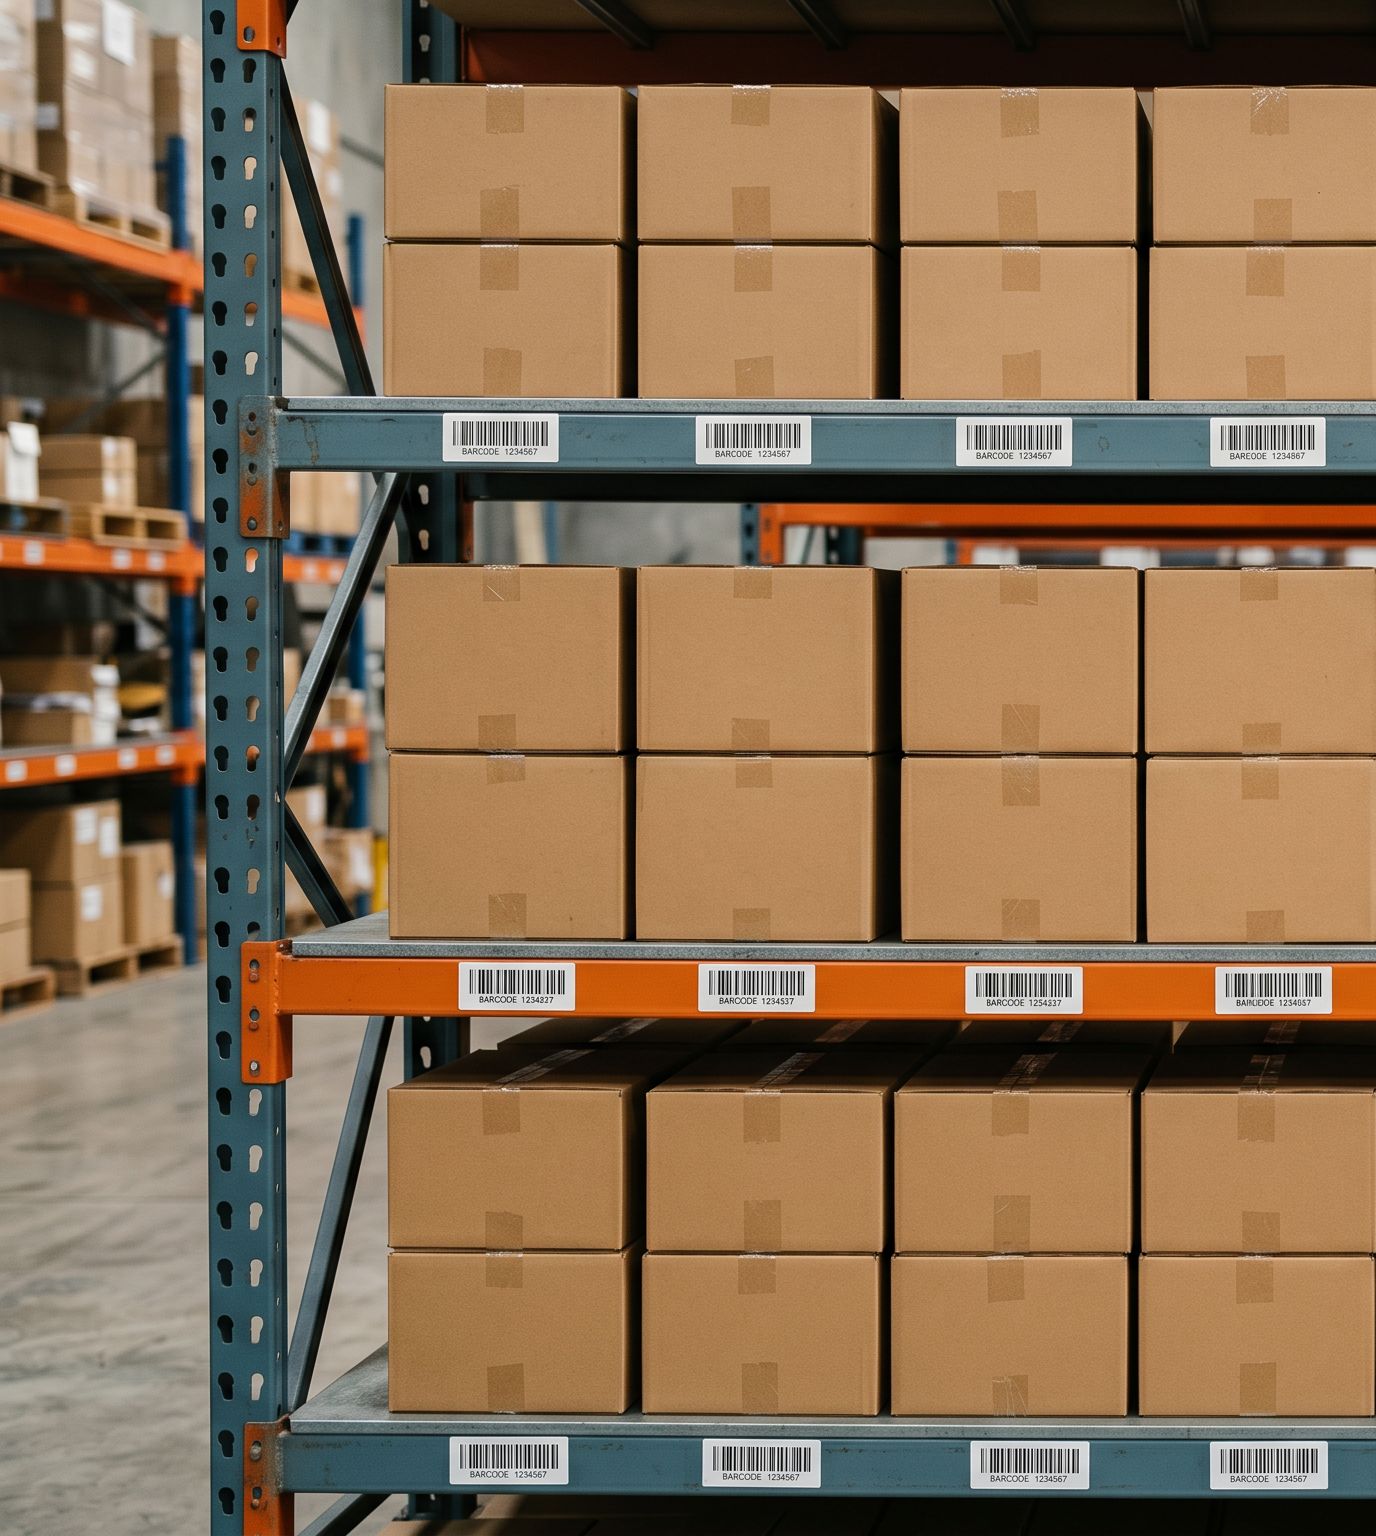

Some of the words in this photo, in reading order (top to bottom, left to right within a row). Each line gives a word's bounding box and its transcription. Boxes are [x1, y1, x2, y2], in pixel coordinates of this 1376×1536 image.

[504, 447, 538, 456] 1234567
[758, 449, 791, 458] 1234567
[1019, 451, 1053, 460] 1234567
[514, 1470, 548, 1479] 1234567
[722, 1472, 762, 1482] BARCODE
[767, 1472, 800, 1482] 1234567
[1034, 1474, 1068, 1483] 1234567
[1229, 1474, 1270, 1483] BARCODE
[1274, 1474, 1308, 1483] 1234567
